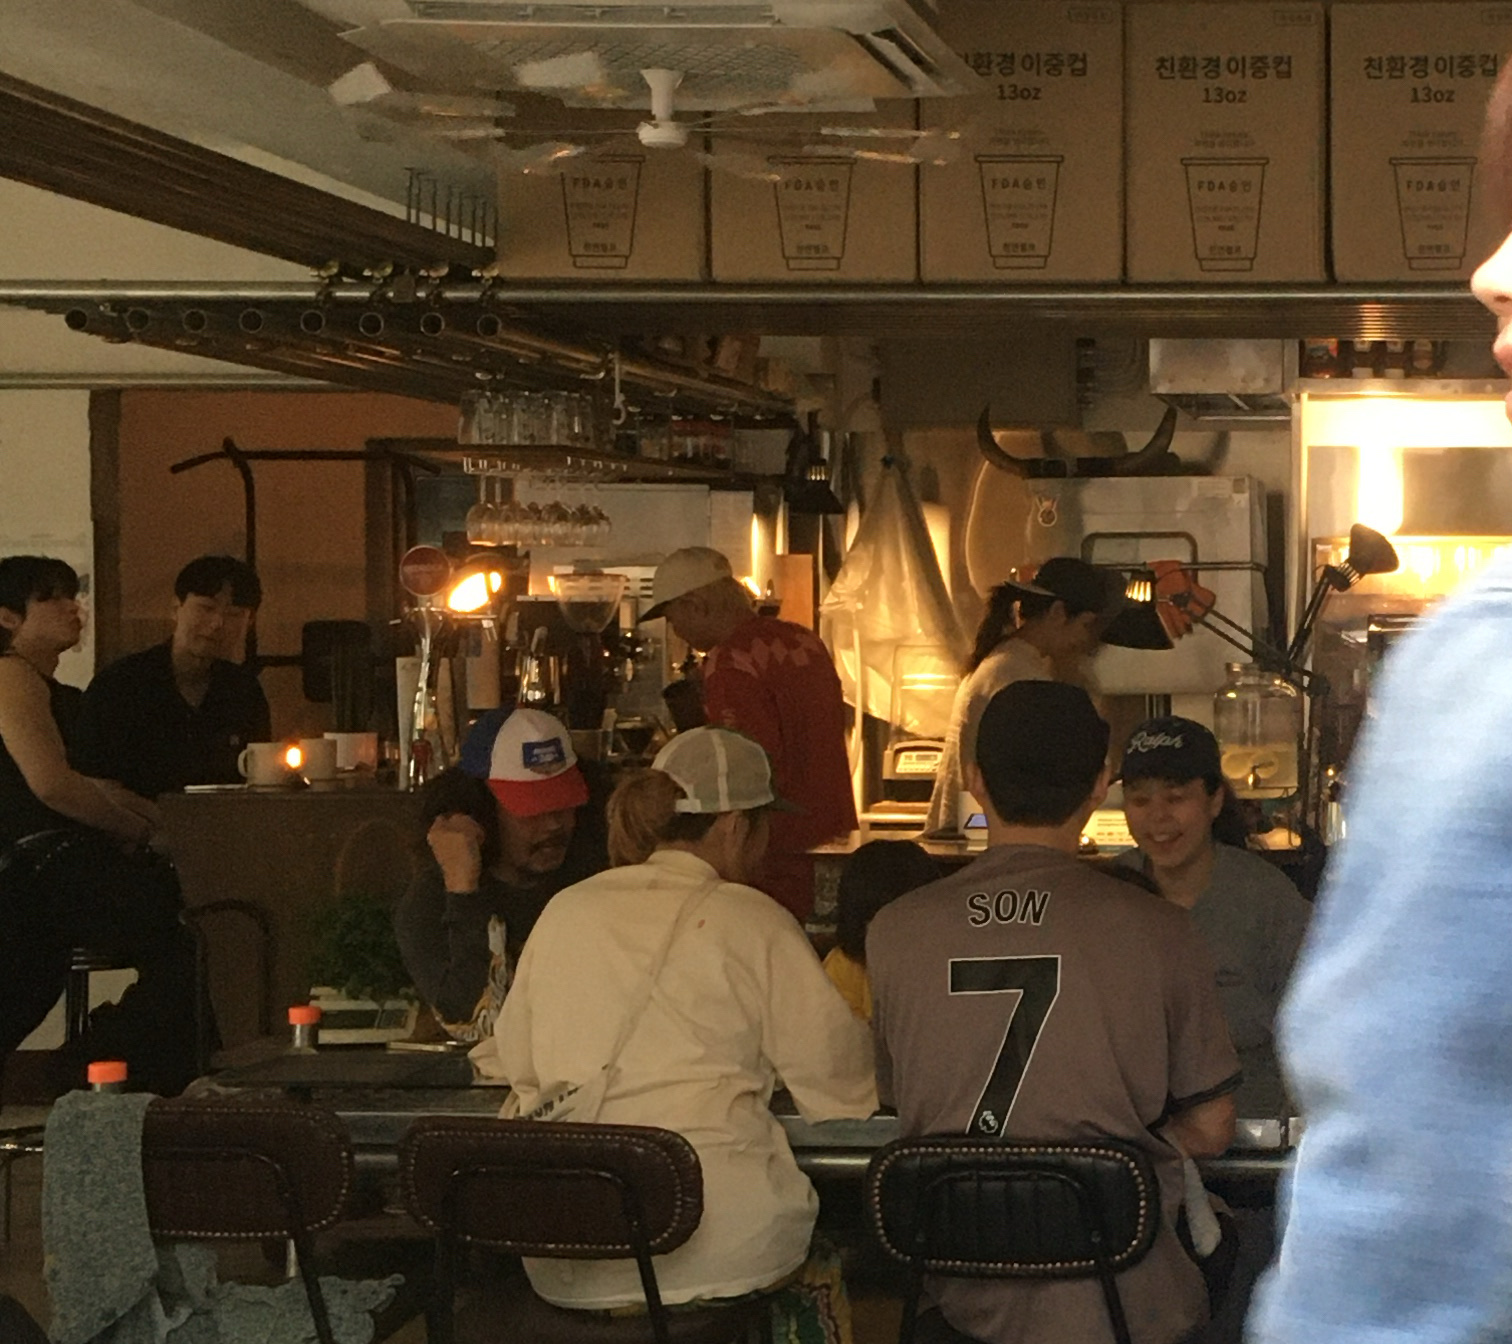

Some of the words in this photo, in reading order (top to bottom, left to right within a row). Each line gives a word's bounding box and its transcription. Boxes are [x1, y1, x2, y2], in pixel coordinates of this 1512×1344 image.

[1020, 52, 1088, 77] 이중컵
[1155, 56, 1221, 80] 친환경
[1226, 55, 1292, 80] 이중컵
[1363, 55, 1429, 80] 친환경
[1434, 54, 1498, 79] 이중컵
[997, 83, 1042, 101] 13oz
[1202, 87, 1248, 104] 13oz
[1410, 86, 1455, 103] 13oz
[1127, 731, 1184, 754] Ralph
[967, 890, 1050, 927] SON
[949, 955, 1061, 1137] 7
